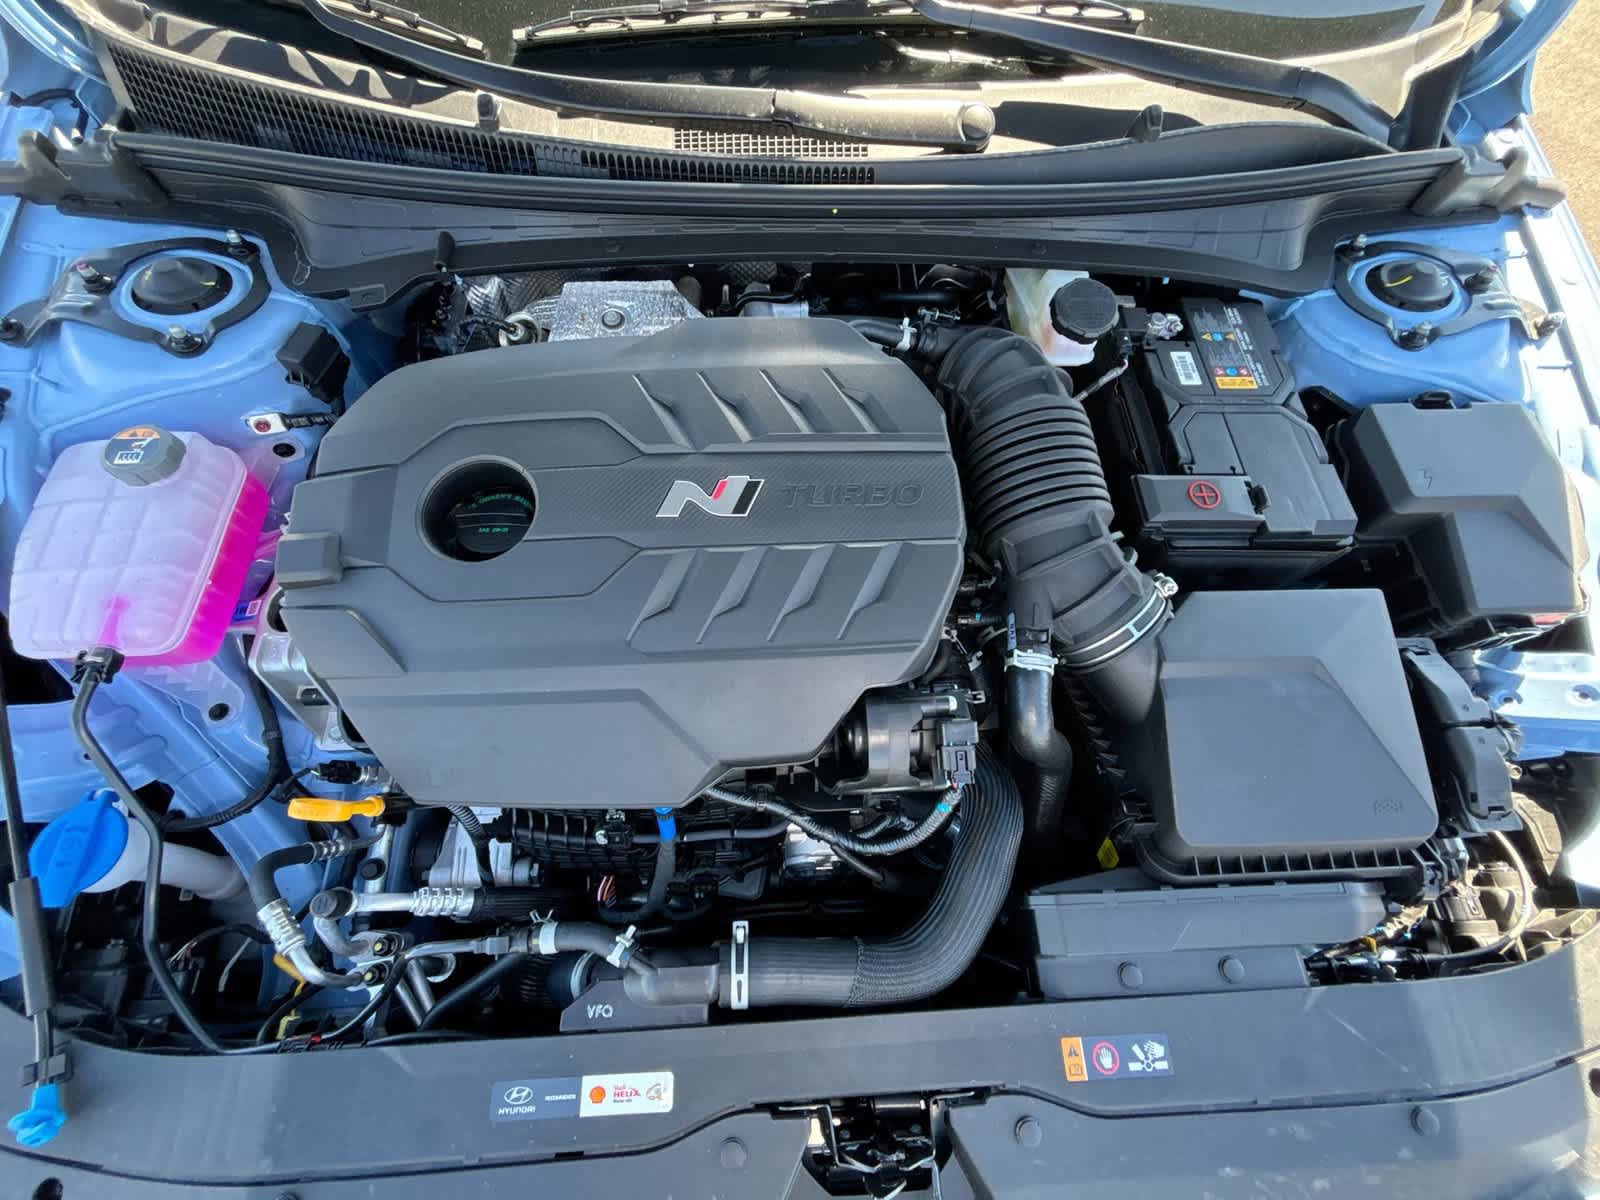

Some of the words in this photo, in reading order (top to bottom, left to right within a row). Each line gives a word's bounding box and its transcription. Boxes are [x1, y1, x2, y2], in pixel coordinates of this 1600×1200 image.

[782, 482, 925, 509] TURBO
[613, 1087, 641, 1098] HELIX
[498, 1105, 536, 1115] HYUNDAI
